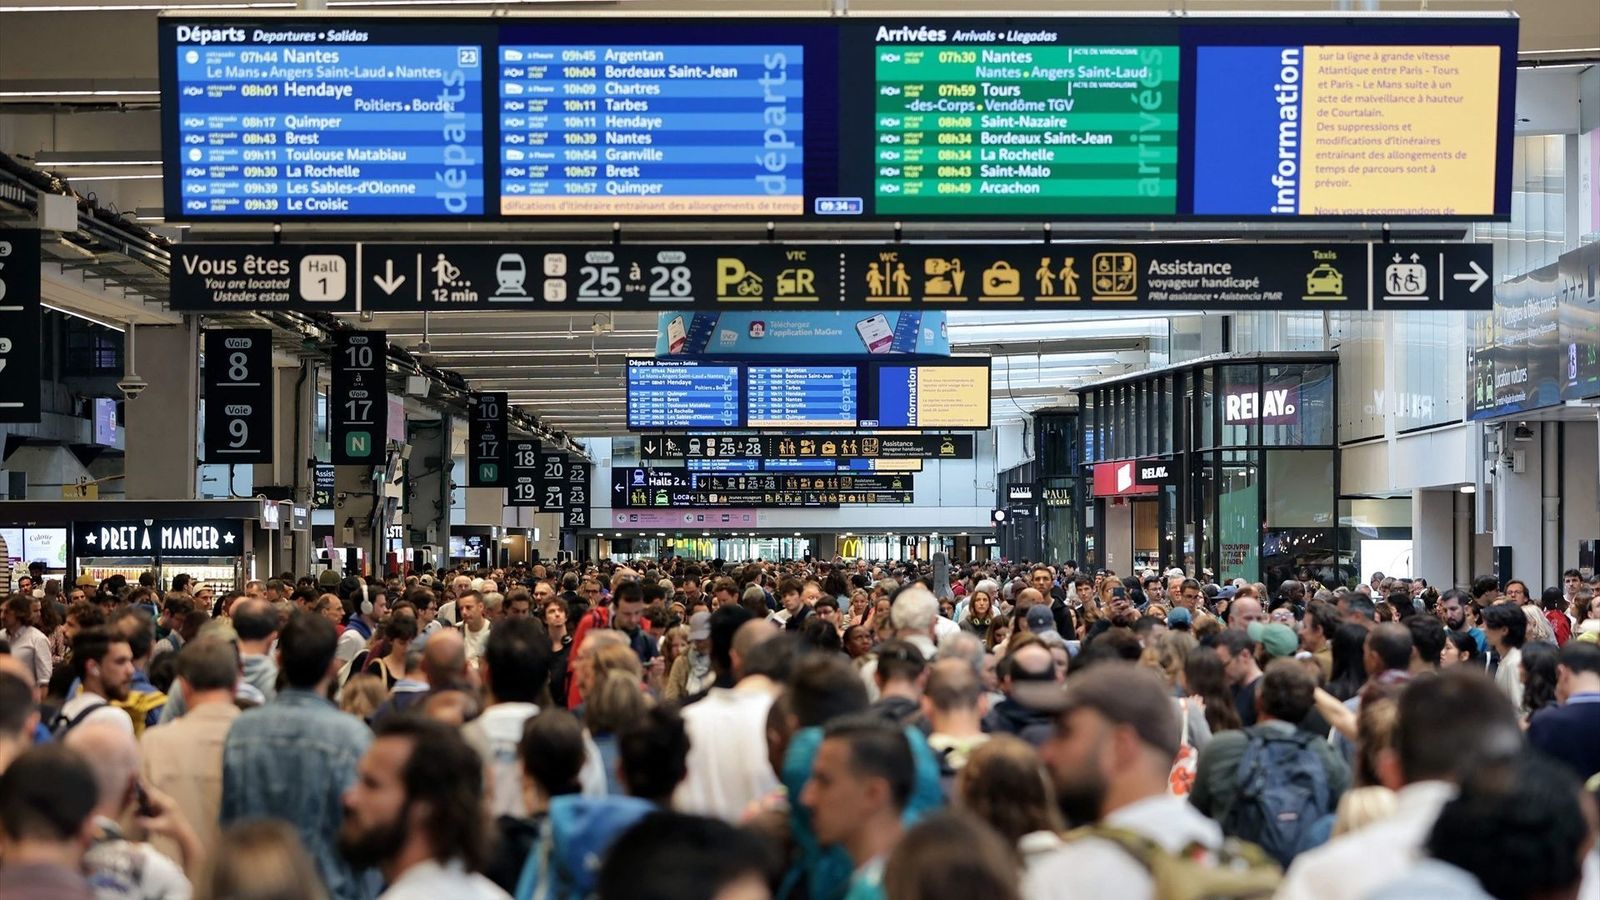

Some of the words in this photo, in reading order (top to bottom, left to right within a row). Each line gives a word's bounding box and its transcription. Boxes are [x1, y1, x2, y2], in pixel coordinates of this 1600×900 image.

[176, 26, 246, 45] Départs
[253, 30, 316, 44] Departures
[327, 30, 369, 42] Salidas
[875, 26, 946, 42] Arrivées
[952, 30, 996, 42] Arrivals
[1007, 30, 1057, 44] Llegadas
[240, 51, 278, 63] 07h44
[283, 49, 339, 63] Nantes
[460, 51, 476, 63] 23
[604, 50, 664, 64] Argentan
[938, 51, 976, 63] 07h30
[982, 50, 1033, 63] Nantes
[1318, 53, 1334, 61] sur
[1336, 52, 1345, 61] la
[1347, 52, 1371, 63] ligne
[1381, 52, 1415, 63] grande
[1417, 52, 1450, 61] vitesse
[207, 67, 222, 78] Le
[225, 67, 261, 78] Mans
[269, 67, 313, 81] Angers
[316, 66, 386, 78] Saint-Laud
[396, 67, 442, 78] Nantes
[604, 65, 666, 78] Bordeaux
[668, 65, 738, 79] Saint-Jean
[975, 66, 1021, 78] Nantes
[1031, 66, 1075, 81] Angers
[1078, 66, 1147, 79] Saint-Laud
[1318, 66, 1369, 76] Atlantique
[1371, 67, 1397, 75] entre
[1399, 66, 1423, 75] Paris
[1433, 66, 1459, 75] Tours
[241, 85, 278, 97] 08h01
[284, 83, 353, 100] Hendaye
[604, 82, 661, 95] Chartres
[938, 85, 976, 97] 07h59
[981, 83, 1021, 97] Tours
[354, 99, 403, 112] Poitiers
[605, 99, 648, 111] Tarbes
[904, 99, 975, 114] -des-Corps
[985, 98, 1045, 112] Vendôme
[1048, 99, 1074, 112] TGV
[1316, 108, 1329, 117] de
[1331, 108, 1384, 117] Courtalain.
[242, 116, 276, 128] 08h17
[284, 115, 342, 131] Quimper
[605, 115, 662, 130] Hendaye
[755, 52, 796, 195] départs
[981, 116, 1067, 128] Saint-Nazaire
[1130, 48, 1163, 197] arrivées
[1271, 48, 1299, 214] information
[242, 133, 277, 144] 08h43
[285, 132, 319, 145] Brest
[436, 68, 475, 214] départs
[605, 132, 652, 145] Nantes
[981, 133, 1041, 145] Bordeaux
[1044, 133, 1112, 146] Saint-Jean
[243, 150, 277, 161] 09h11
[286, 149, 344, 162] Toulouse
[347, 149, 407, 162] Matabiau
[605, 148, 663, 161] Granville
[980, 150, 996, 161] La
[999, 149, 1055, 161] Rochelle
[243, 166, 278, 177] 09h30
[286, 166, 301, 178] La
[304, 165, 361, 178] Rochelle
[606, 165, 640, 178] Brest
[980, 166, 1051, 178] Saint-Malo
[244, 183, 278, 194] 09h39
[287, 182, 308, 194] Les
[311, 181, 416, 195] Sables-d'Olonne
[606, 182, 663, 196] Quimper
[980, 182, 1040, 194] Arcachon
[244, 199, 279, 211] 09h39
[287, 199, 302, 211] Le
[306, 198, 349, 211] Croisic
[820, 201, 848, 211] 09:34
[590, 252, 611, 262] Voie
[661, 252, 682, 262] Voie
[786, 251, 807, 261] VTC
[879, 252, 898, 262] WC
[1312, 250, 1337, 260] Taxis
[182, 254, 237, 275] Vous
[243, 253, 290, 275] êtes
[308, 259, 339, 273] Hall
[629, 262, 641, 280] à
[1148, 259, 1232, 275] Assistance
[204, 277, 223, 289] You
[225, 279, 246, 289] are
[248, 277, 290, 289] located
[579, 266, 622, 297] 25
[649, 266, 692, 297] 28
[717, 258, 746, 296] P
[1148, 277, 1198, 290] voyageur
[1201, 276, 1259, 290] handicapé
[318, 277, 328, 295] 1
[213, 290, 260, 302] Ustedes
[262, 291, 290, 302] estan
[432, 289, 448, 301] 12
[451, 289, 478, 301] min
[1148, 291, 1167, 301] PRM
[1168, 291, 1212, 301] assistance
[1219, 291, 1262, 301] Asistencia
[1263, 291, 1283, 301] PMR
[814, 328, 842, 336] MaGare
[228, 339, 249, 348] Voie
[345, 346, 373, 368] 10
[228, 352, 249, 382] 8
[355, 373, 362, 383] à
[720, 375, 736, 426] départs
[839, 368, 854, 420] départs
[907, 367, 917, 427] information
[228, 406, 249, 415] Voie
[345, 400, 374, 421] 17
[479, 403, 498, 418] 10
[228, 418, 249, 448] 9
[352, 437, 365, 451] N
[479, 441, 498, 457] 17
[720, 443, 735, 455] 25
[745, 443, 762, 455] 28
[515, 451, 534, 466] 18
[484, 467, 493, 478] N
[545, 463, 563, 477] 20
[570, 470, 585, 480] 22
[1142, 466, 1166, 480] RELAY
[649, 477, 672, 486] Halls
[674, 477, 680, 486] 2
[515, 484, 534, 499] 19
[570, 491, 585, 502] 23
[1046, 489, 1070, 499] PAUL
[545, 492, 563, 506] 21
[570, 513, 585, 523] 24
[101, 526, 138, 551] PRET
[161, 526, 220, 550] MANGER
